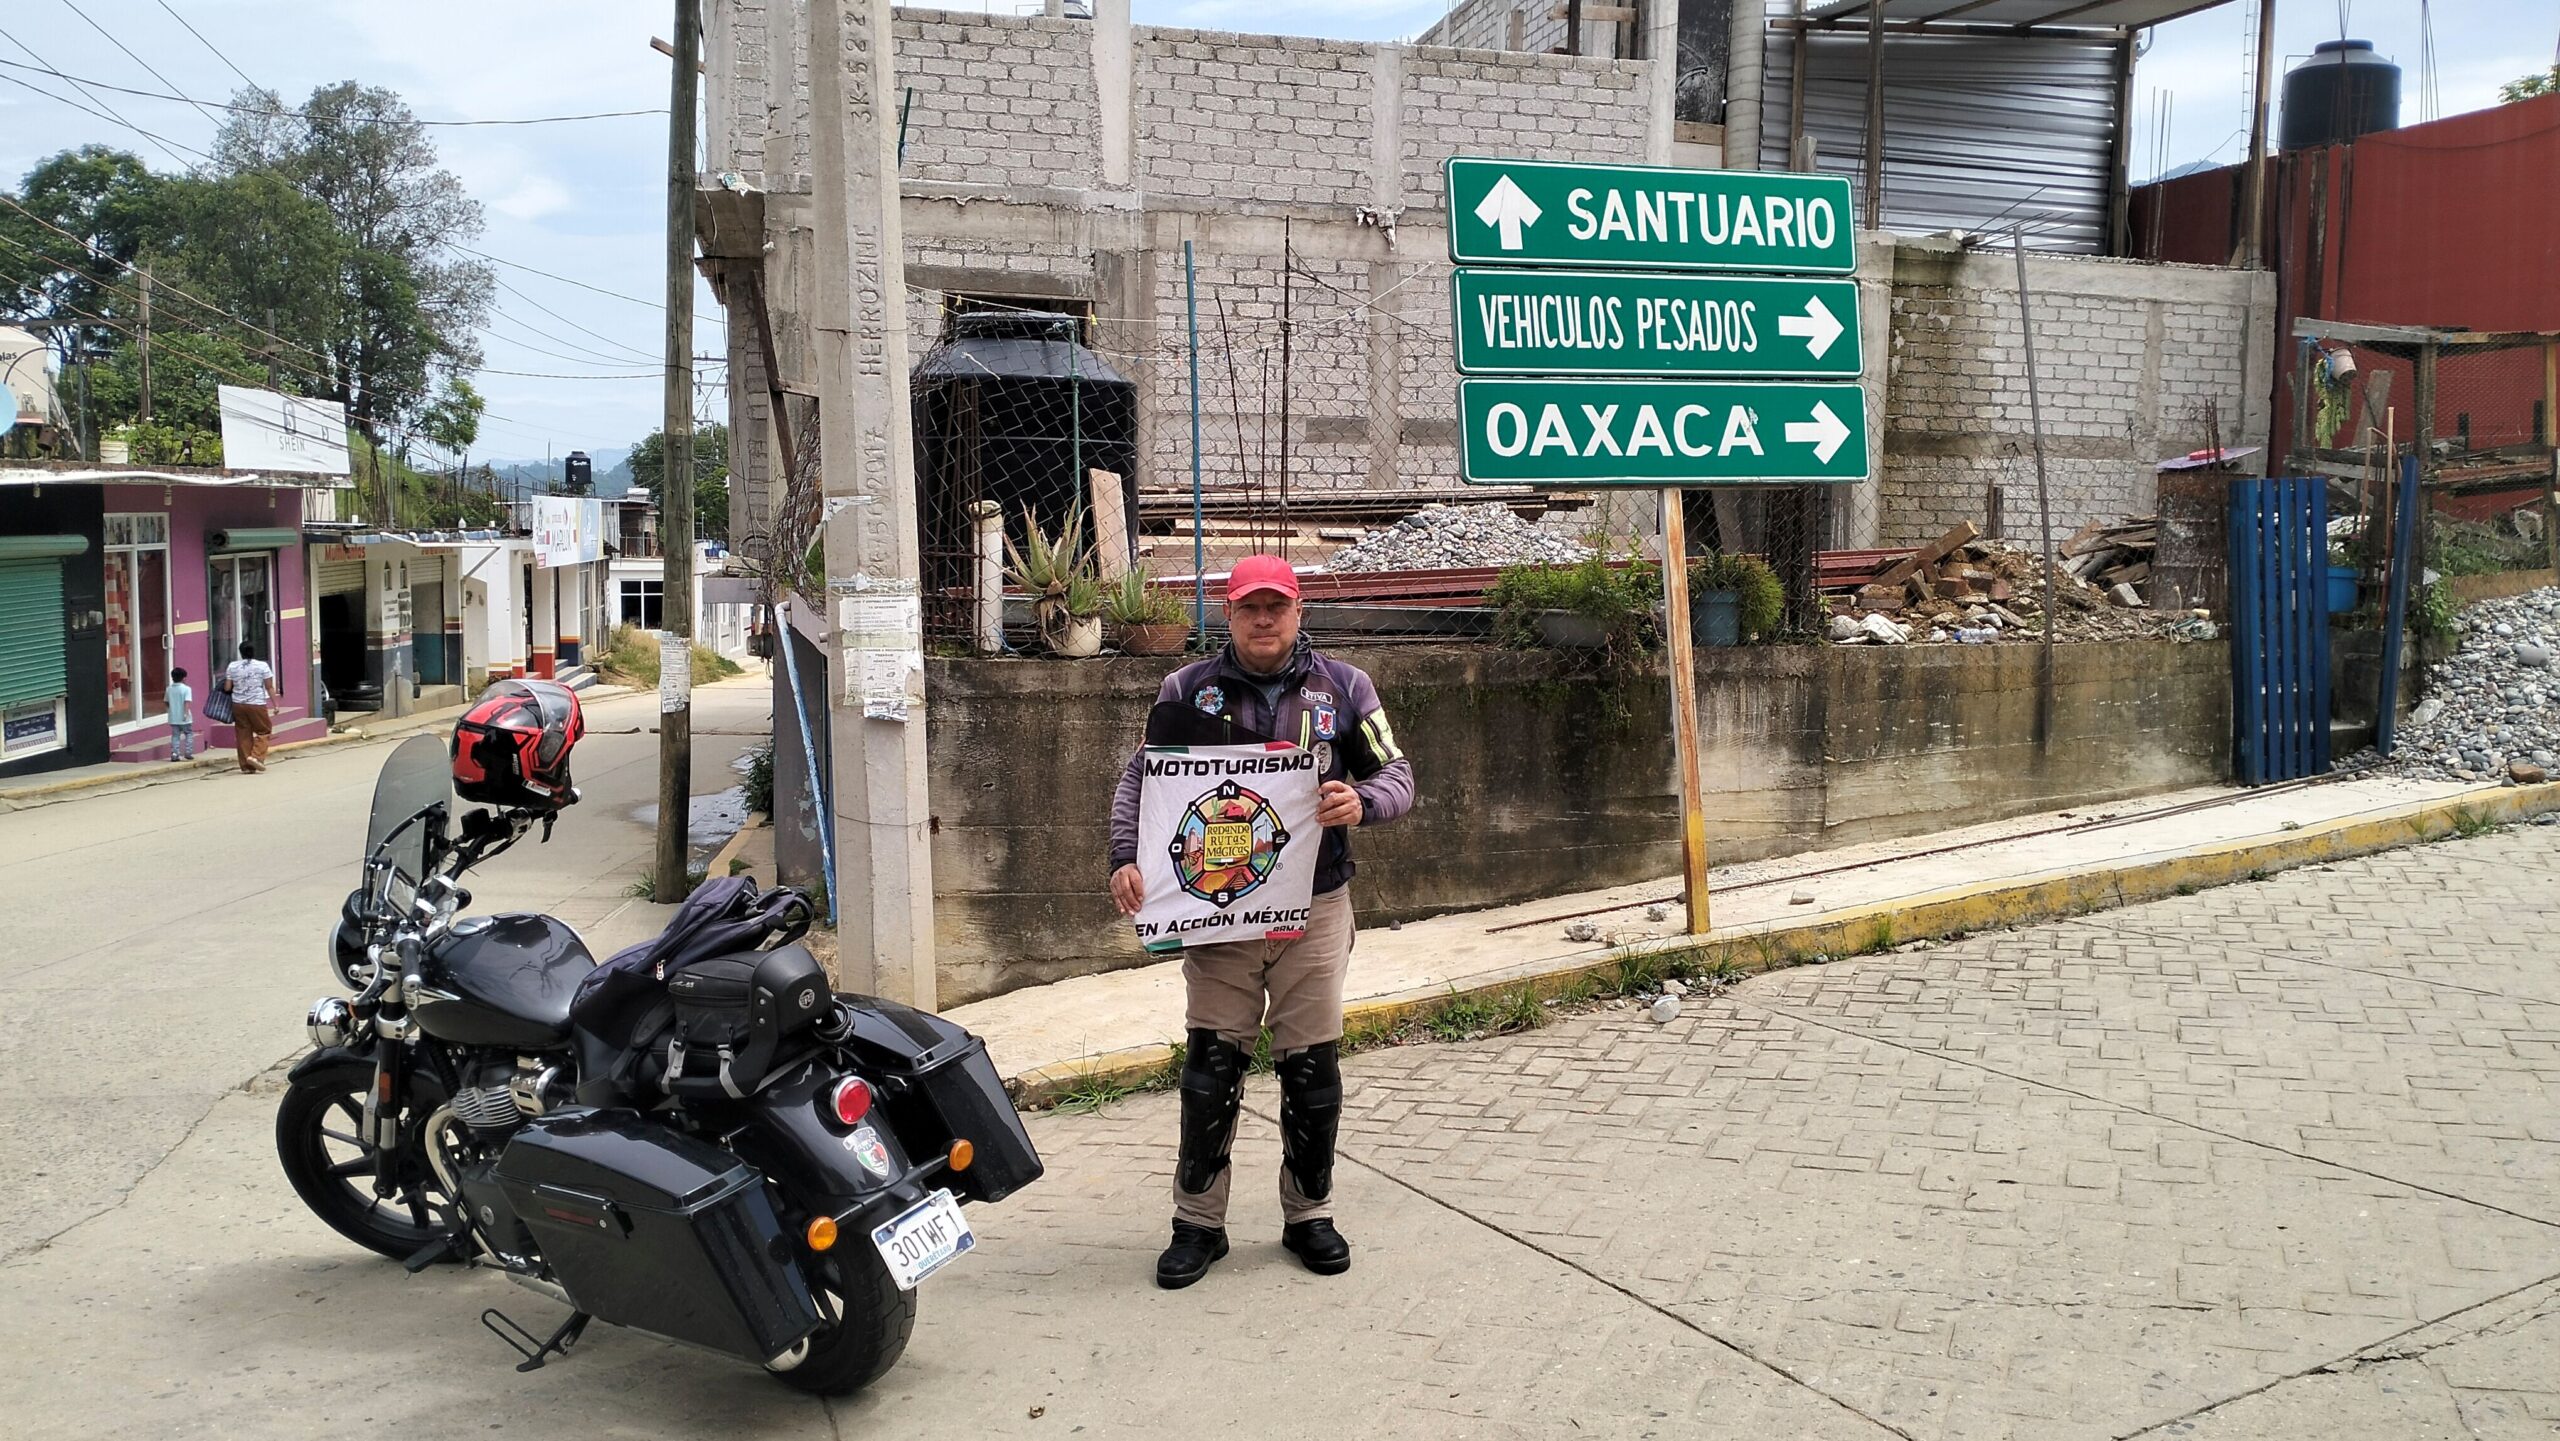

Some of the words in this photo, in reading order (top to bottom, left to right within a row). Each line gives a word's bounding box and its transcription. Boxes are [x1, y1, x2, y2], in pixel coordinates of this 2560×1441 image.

[1567, 187, 1836, 249] SANTUARIO
[1478, 294, 1624, 350] VEHICULOS
[1637, 297, 1757, 353] PESADOS
[1485, 402, 1765, 457] OAXACA
[278, 435, 305, 452] SHEIN
[1145, 753, 1315, 777] MOTOTURISMO
[1223, 785, 1235, 796] N
[1171, 843, 1182, 853] O
[1218, 892, 1229, 902] S
[1136, 922, 1159, 937] EN
[1165, 912, 1235, 934] ACCIÓN
